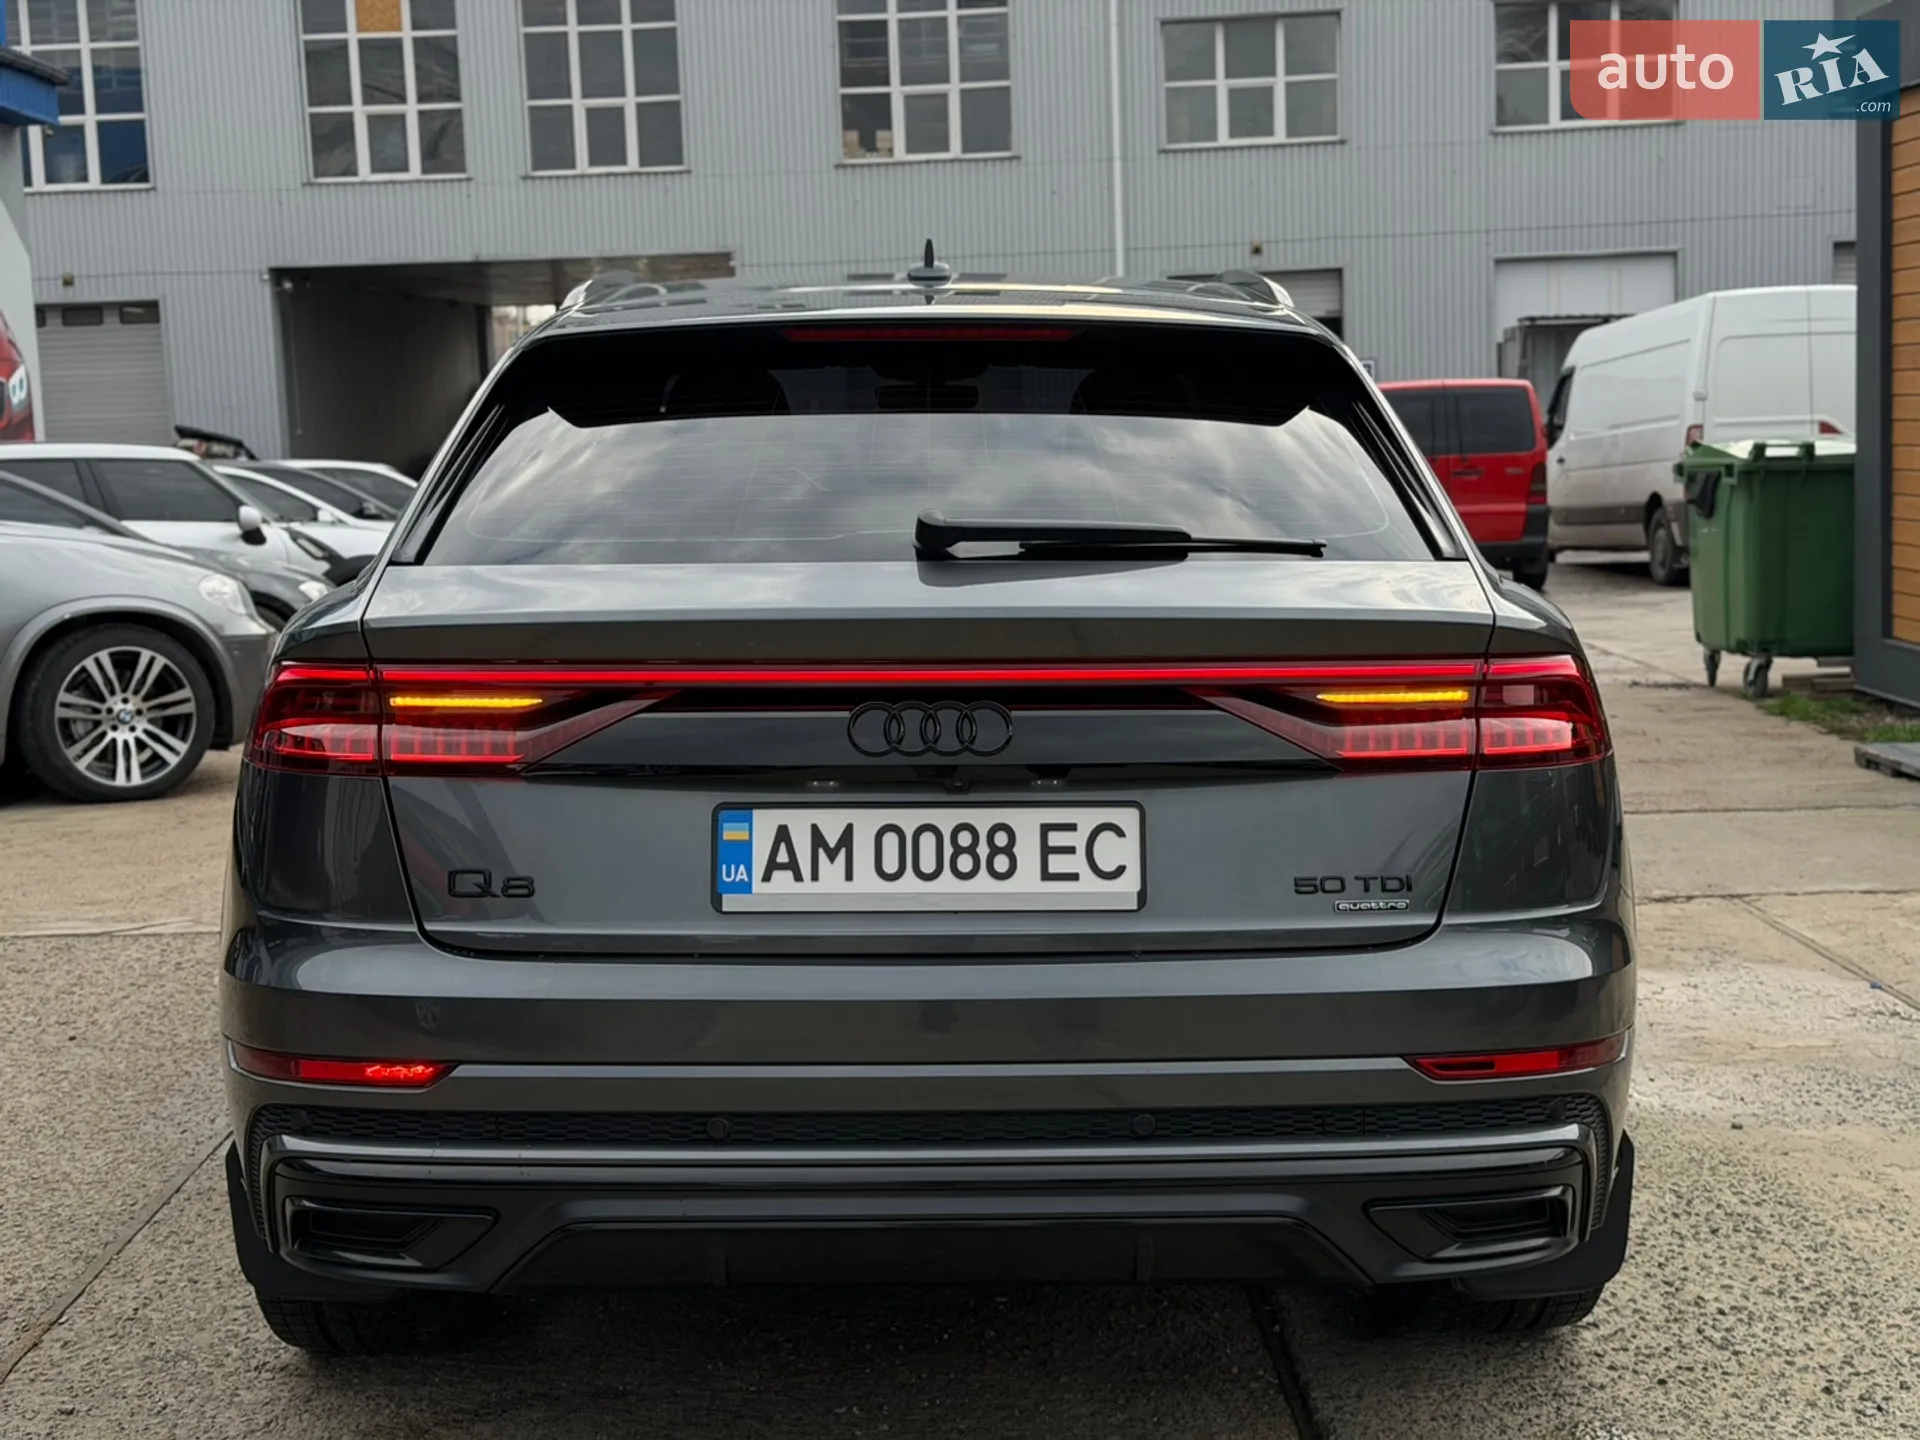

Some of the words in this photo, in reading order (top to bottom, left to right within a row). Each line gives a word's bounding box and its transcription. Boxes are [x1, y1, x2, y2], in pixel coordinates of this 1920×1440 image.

[760, 822, 854, 882] AM
[874, 822, 1018, 882] 0088
[1040, 822, 1127, 882] EC
[722, 864, 748, 882] UA
[448, 869, 535, 898] Q8
[1294, 875, 1346, 894] 50
[1354, 874, 1413, 893] TDI
[1338, 901, 1407, 911] quattro
